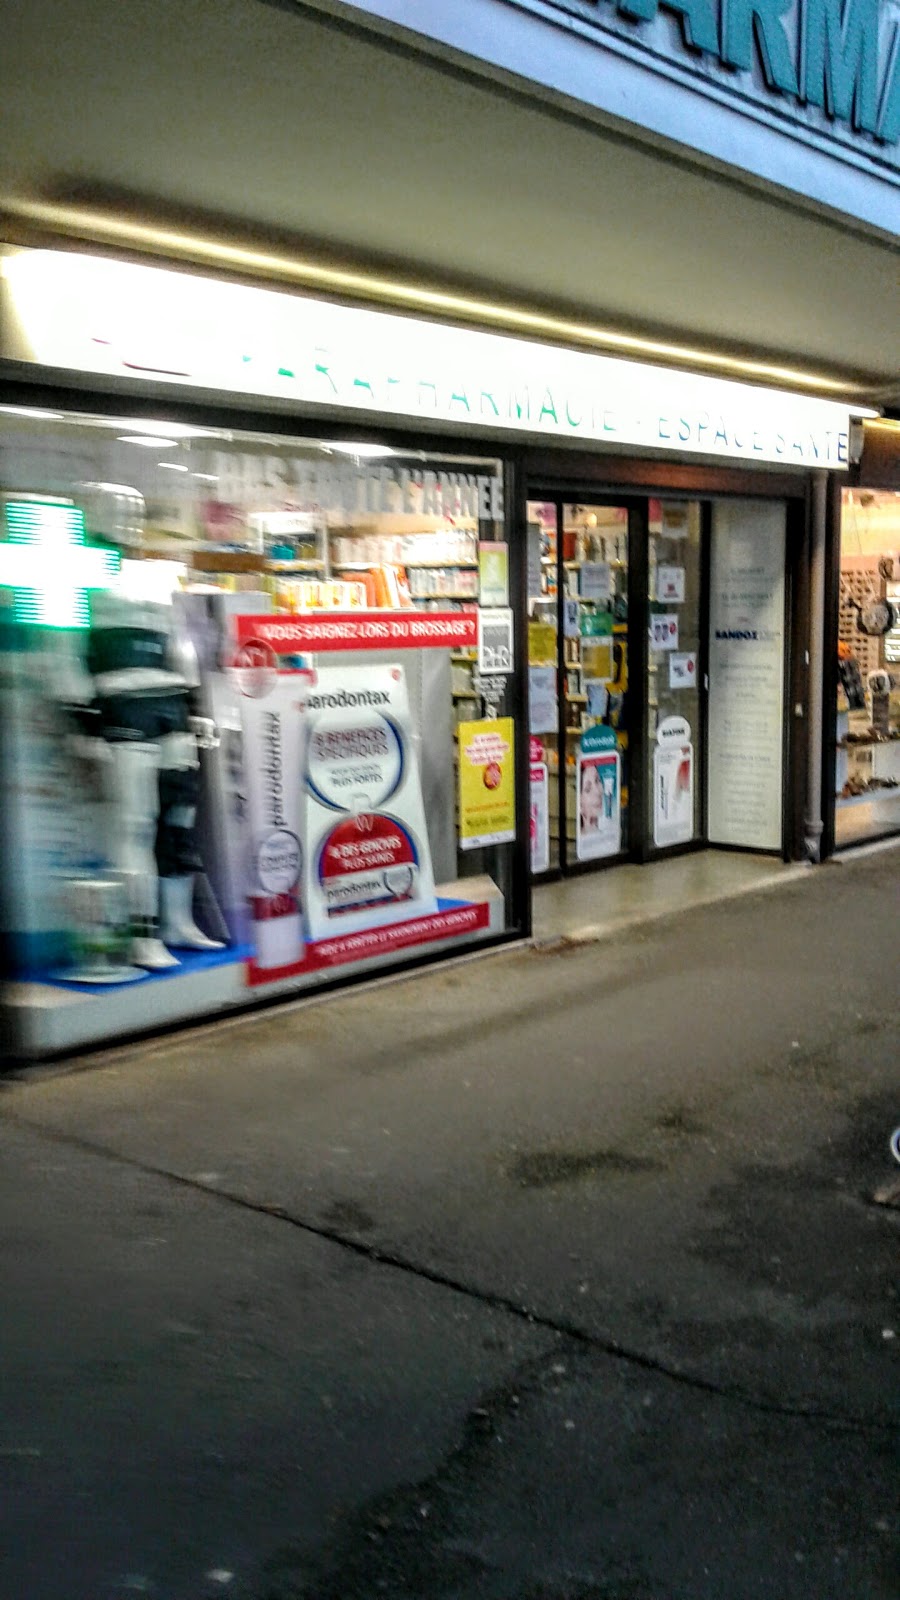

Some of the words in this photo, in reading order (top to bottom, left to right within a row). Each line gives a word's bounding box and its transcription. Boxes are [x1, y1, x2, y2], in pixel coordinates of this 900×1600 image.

[255, 623, 302, 640] VOUS
[302, 622, 358, 640] SAIGNEZ
[358, 621, 389, 638] LORS
[390, 621, 409, 637] DU
[265, 710, 287, 826] parodontax
